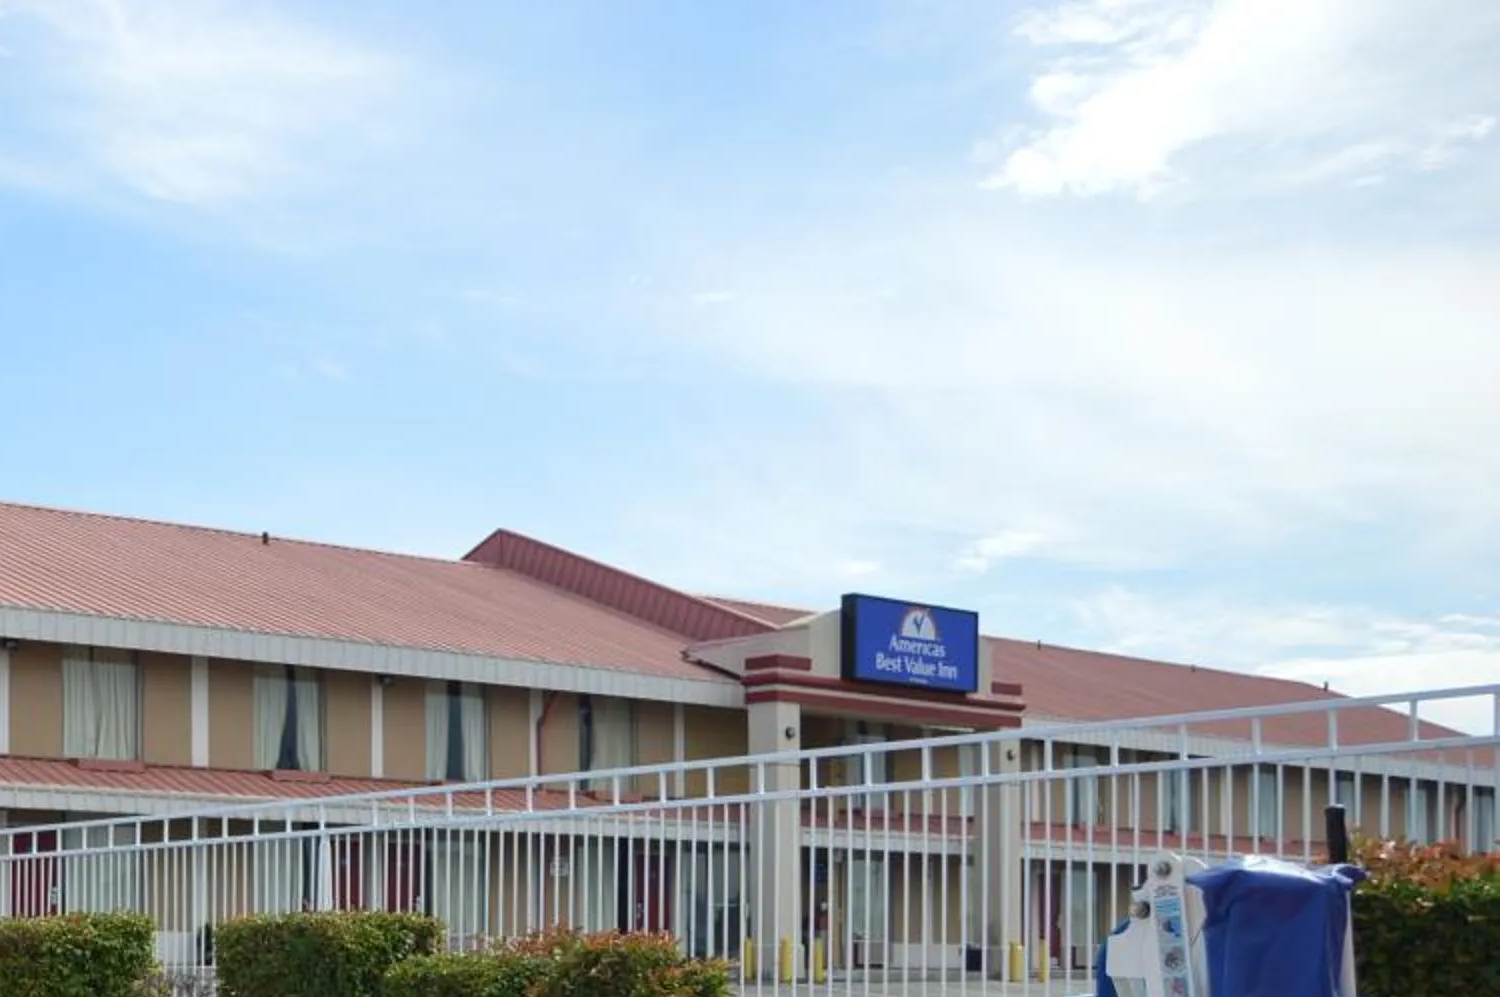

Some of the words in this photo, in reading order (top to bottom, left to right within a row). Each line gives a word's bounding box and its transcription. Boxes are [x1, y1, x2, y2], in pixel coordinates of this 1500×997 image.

[888, 633, 946, 657] Americas
[875, 652, 902, 673] Best
[903, 656, 937, 677] Value
[938, 661, 957, 680] Inn
